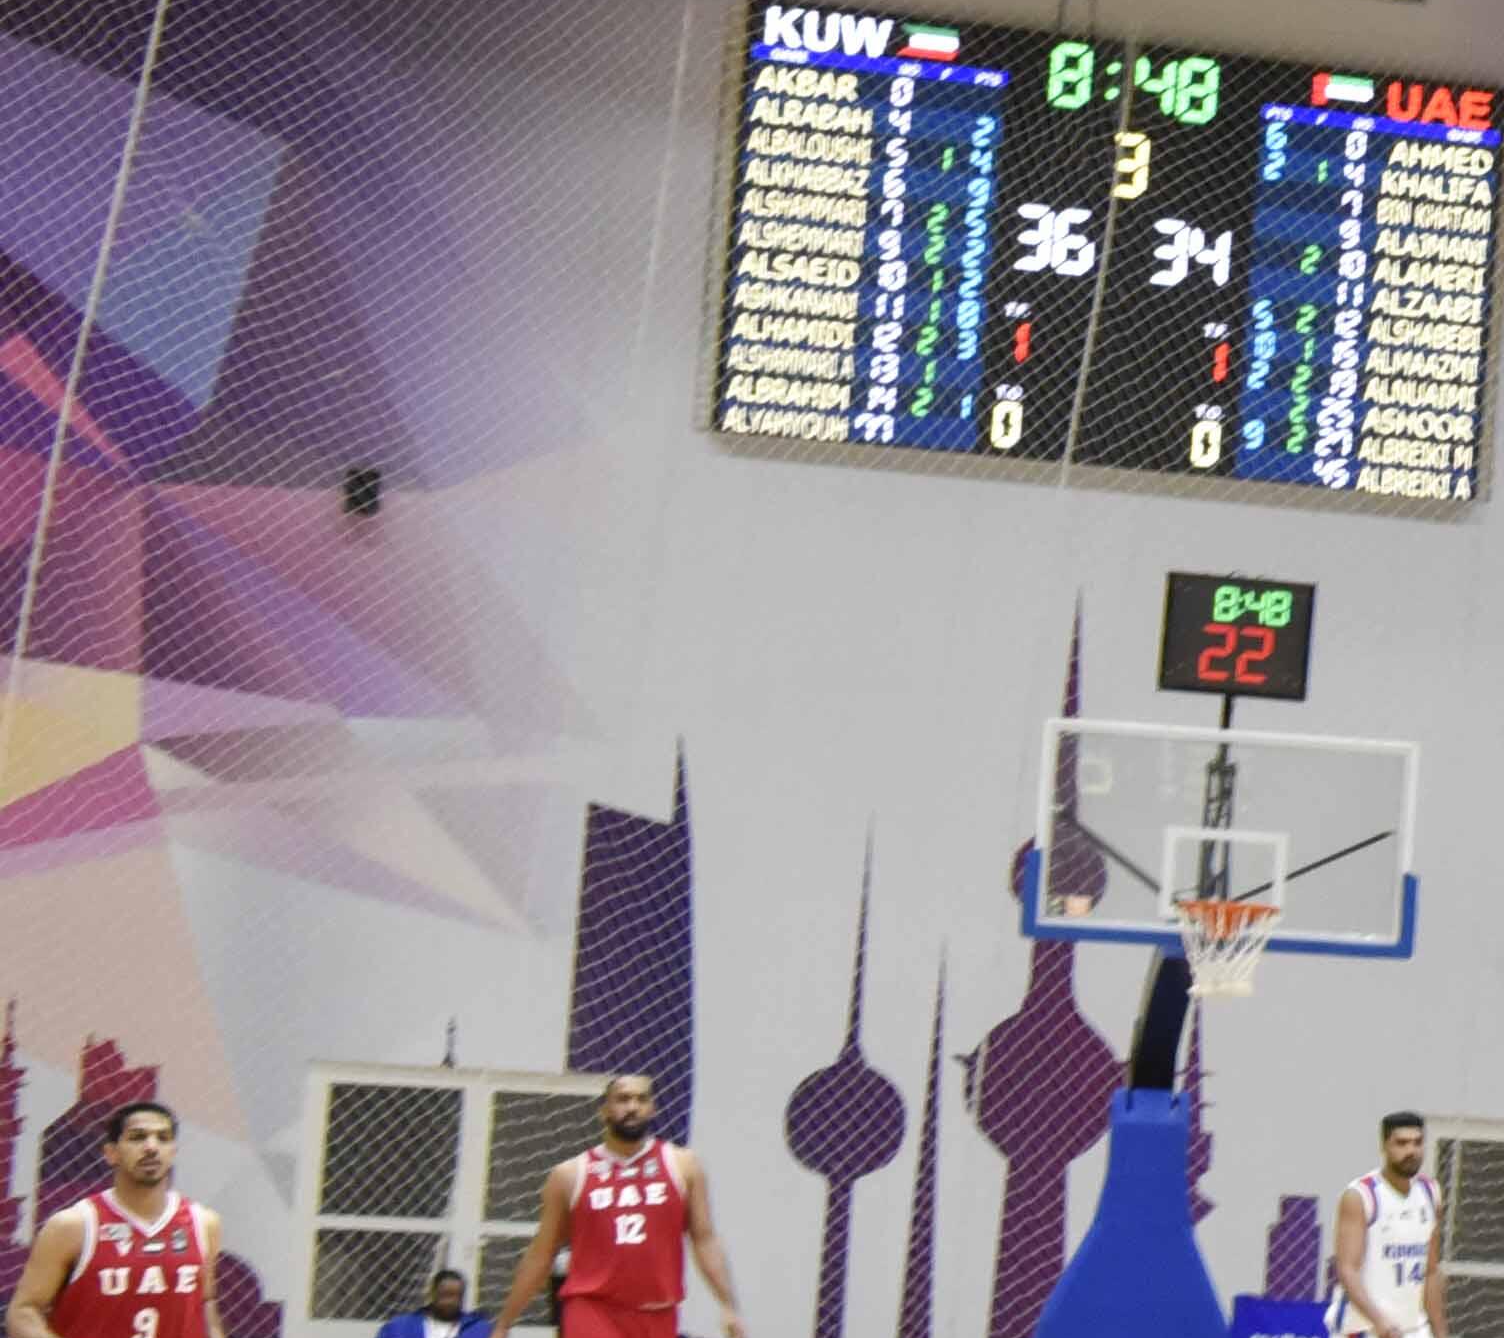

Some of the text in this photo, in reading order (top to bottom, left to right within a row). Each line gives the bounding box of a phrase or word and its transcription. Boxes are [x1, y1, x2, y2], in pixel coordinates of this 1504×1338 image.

[764, 5, 895, 58] KUW
[754, 65, 859, 102] AKBAR
[1047, 41, 1221, 125] 8:48
[1386, 81, 1495, 130] UAE
[1112, 131, 1152, 199] 3
[1388, 140, 1495, 176] AHMED
[1380, 169, 1492, 206] KHALIFA
[1013, 202, 1233, 287] 36 34
[736, 250, 861, 288] ALSAEID
[1371, 257, 1487, 295] ALAMERI
[1013, 322, 1032, 364] 1
[1212, 342, 1231, 384] 1
[990, 400, 1023, 449] 0
[1190, 420, 1222, 469] 0
[1360, 406, 1476, 443] ASHOOR
[1213, 585, 1293, 627] 8:48
[1197, 623, 1276, 685] 22
[588, 1182, 669, 1210] UAE
[614, 1213, 648, 1245] 12
[98, 1265, 200, 1296] UAE
